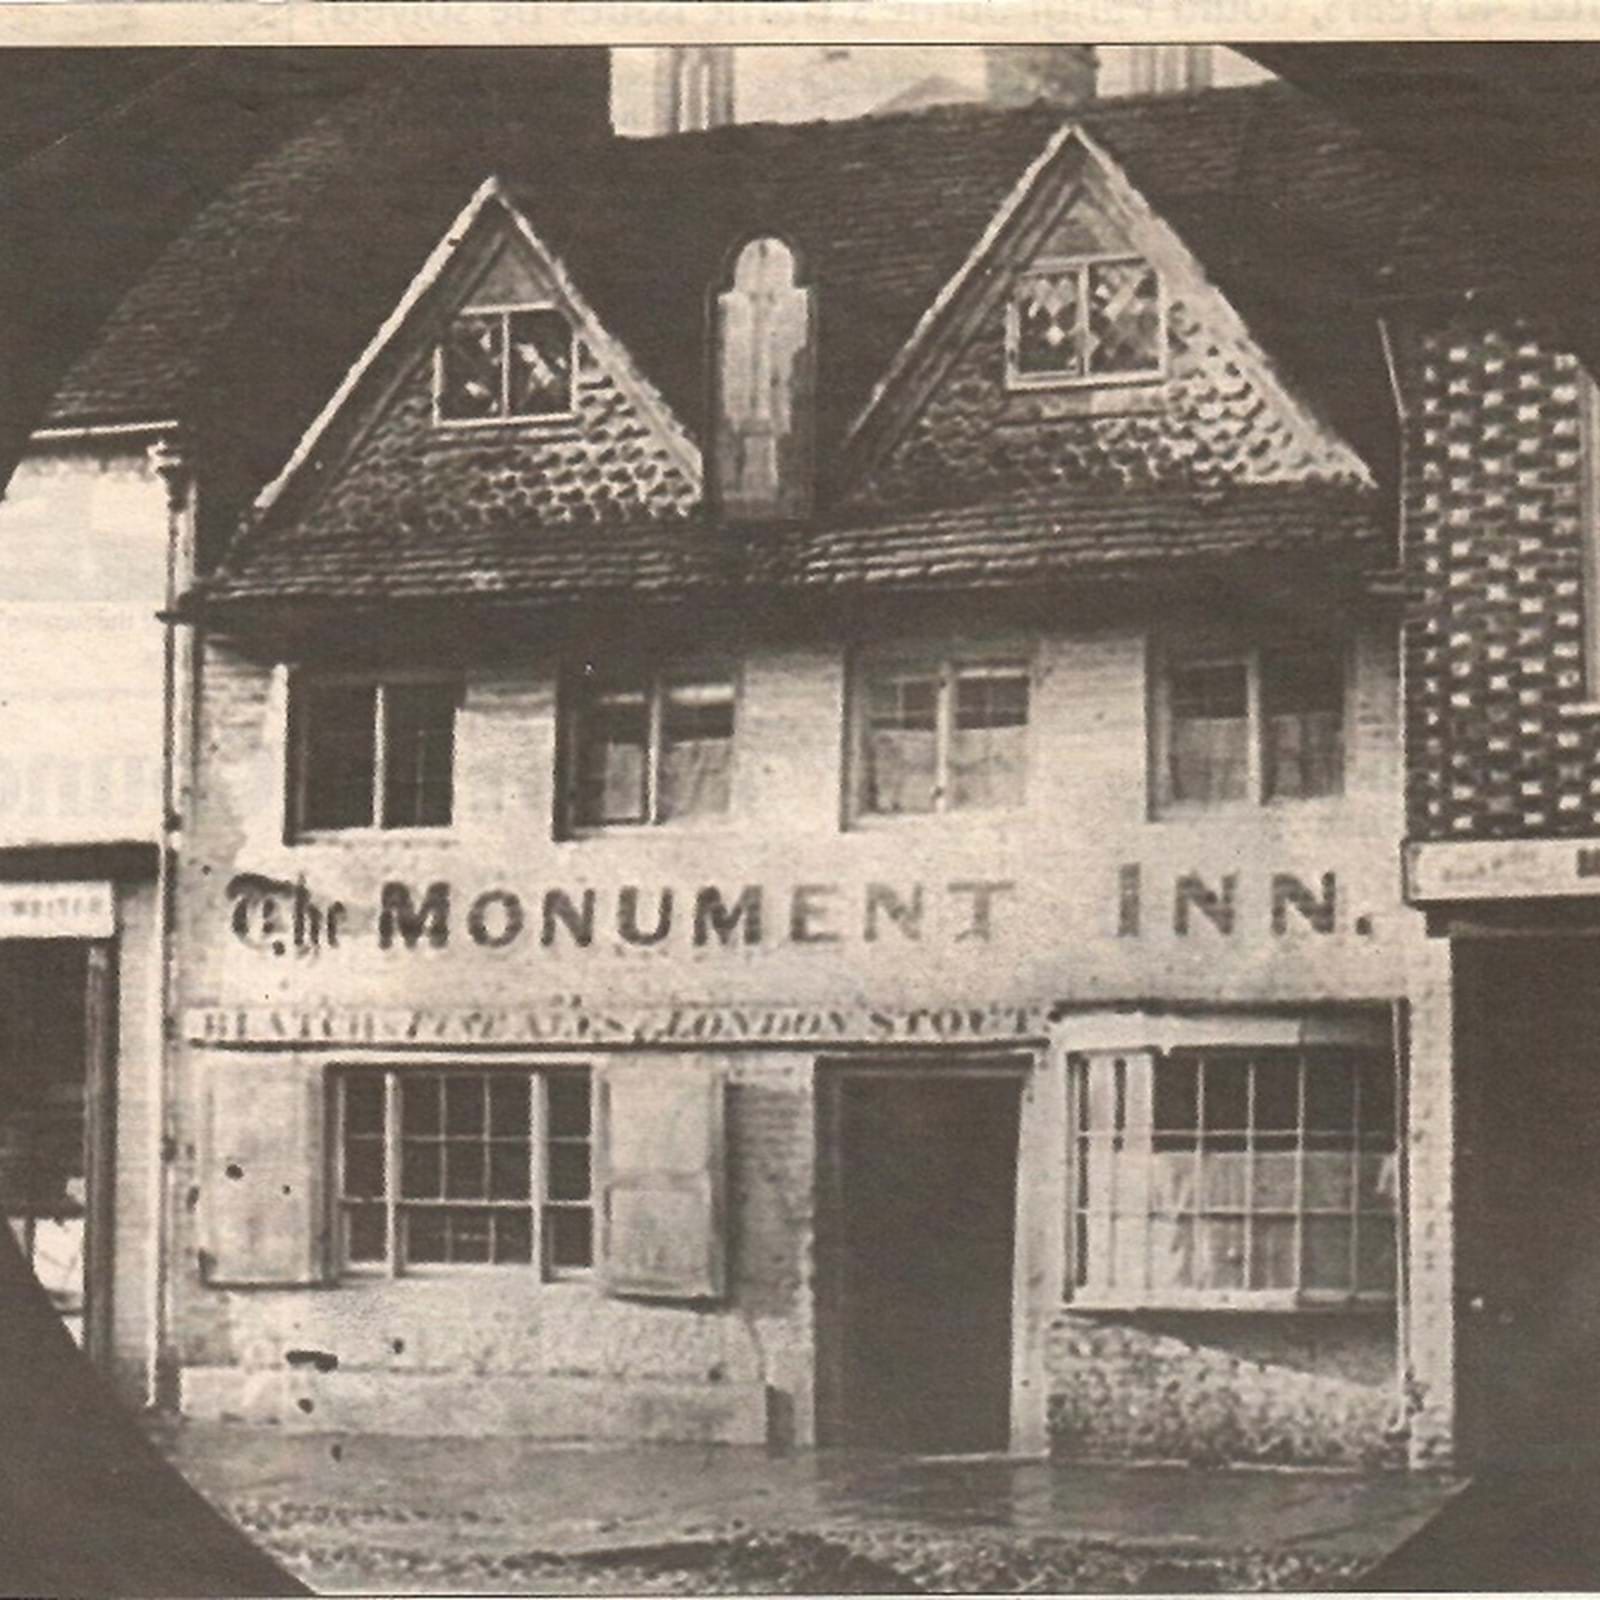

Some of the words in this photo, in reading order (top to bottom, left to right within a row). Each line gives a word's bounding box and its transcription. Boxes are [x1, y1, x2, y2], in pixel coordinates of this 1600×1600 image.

[378, 880, 1014, 950] MONUMENT
[1116, 862, 1372, 937] INN.
[664, 1007, 847, 1037] LONDON
